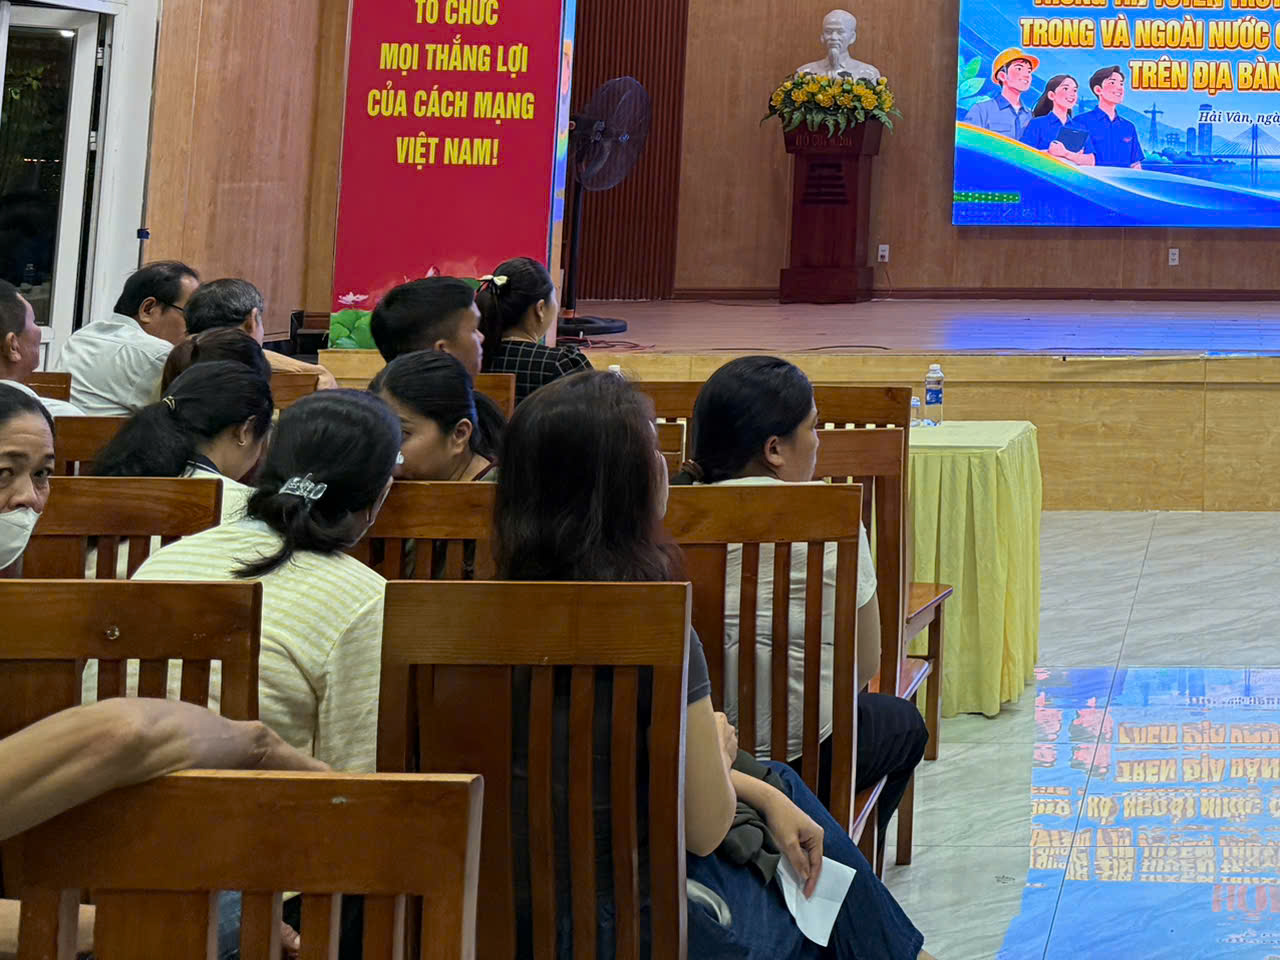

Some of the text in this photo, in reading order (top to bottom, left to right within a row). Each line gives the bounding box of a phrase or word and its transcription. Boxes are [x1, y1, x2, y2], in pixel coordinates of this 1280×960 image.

[1020, 17, 1095, 48] TRONG
[1100, 14, 1132, 48] VÀ
[1134, 14, 1205, 50] NGOÀI
[1208, 15, 1271, 50] NƯỚC
[380, 34, 529, 78] MỌI THẮNG LỢI
[1129, 55, 1188, 91] TRÊN
[1193, 60, 1232, 96] ĐỊA
[367, 80, 536, 124] CỦA CÁCH MẠNG
[1199, 110, 1222, 123] Hải
[1226, 111, 1253, 124] Vân,
[396, 131, 500, 170] VIỆT NAM!
